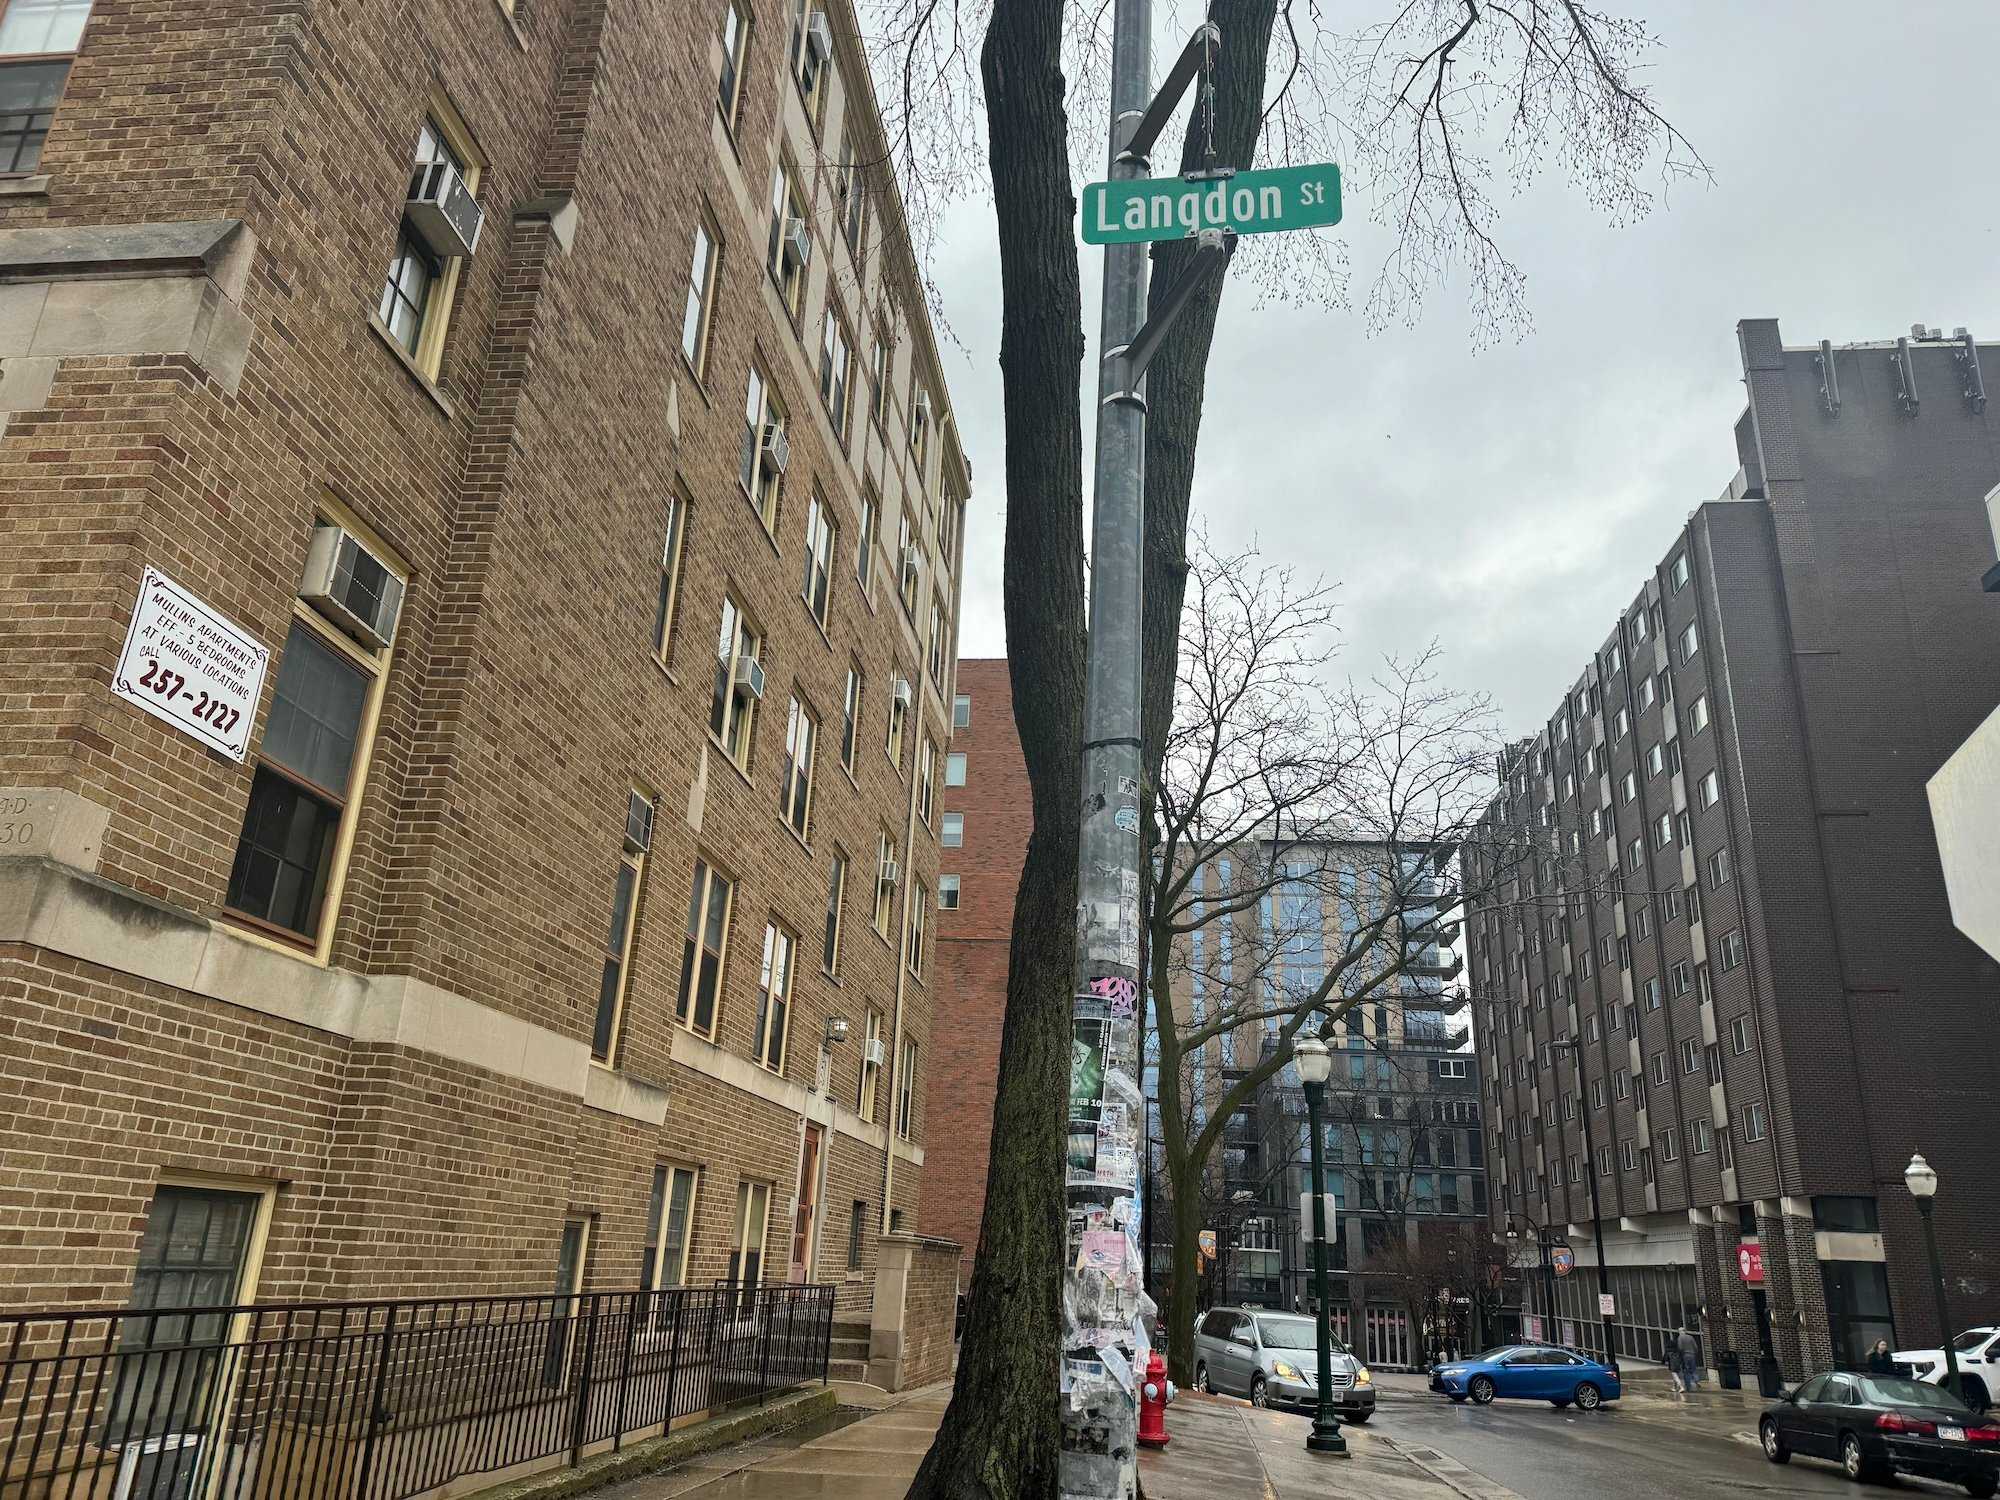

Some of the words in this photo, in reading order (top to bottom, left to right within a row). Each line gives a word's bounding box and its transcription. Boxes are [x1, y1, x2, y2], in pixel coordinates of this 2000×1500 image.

[1097, 180, 1282, 232] Langdon
[1300, 181, 1325, 206] St
[139, 645, 160, 659] CALL
[141, 625, 158, 640] AT
[159, 635, 202, 669] VARIOUS
[202, 664, 250, 700] LOCATIONS
[152, 592, 196, 628] MULLINS
[198, 624, 257, 670] APARTMENTS
[156, 615, 177, 632] EFF
[186, 634, 195, 645] 5
[197, 640, 247, 680] BEDROOMS
[139, 660, 240, 734] 257-2127
[1090, 1098, 1102, 1107] 10
